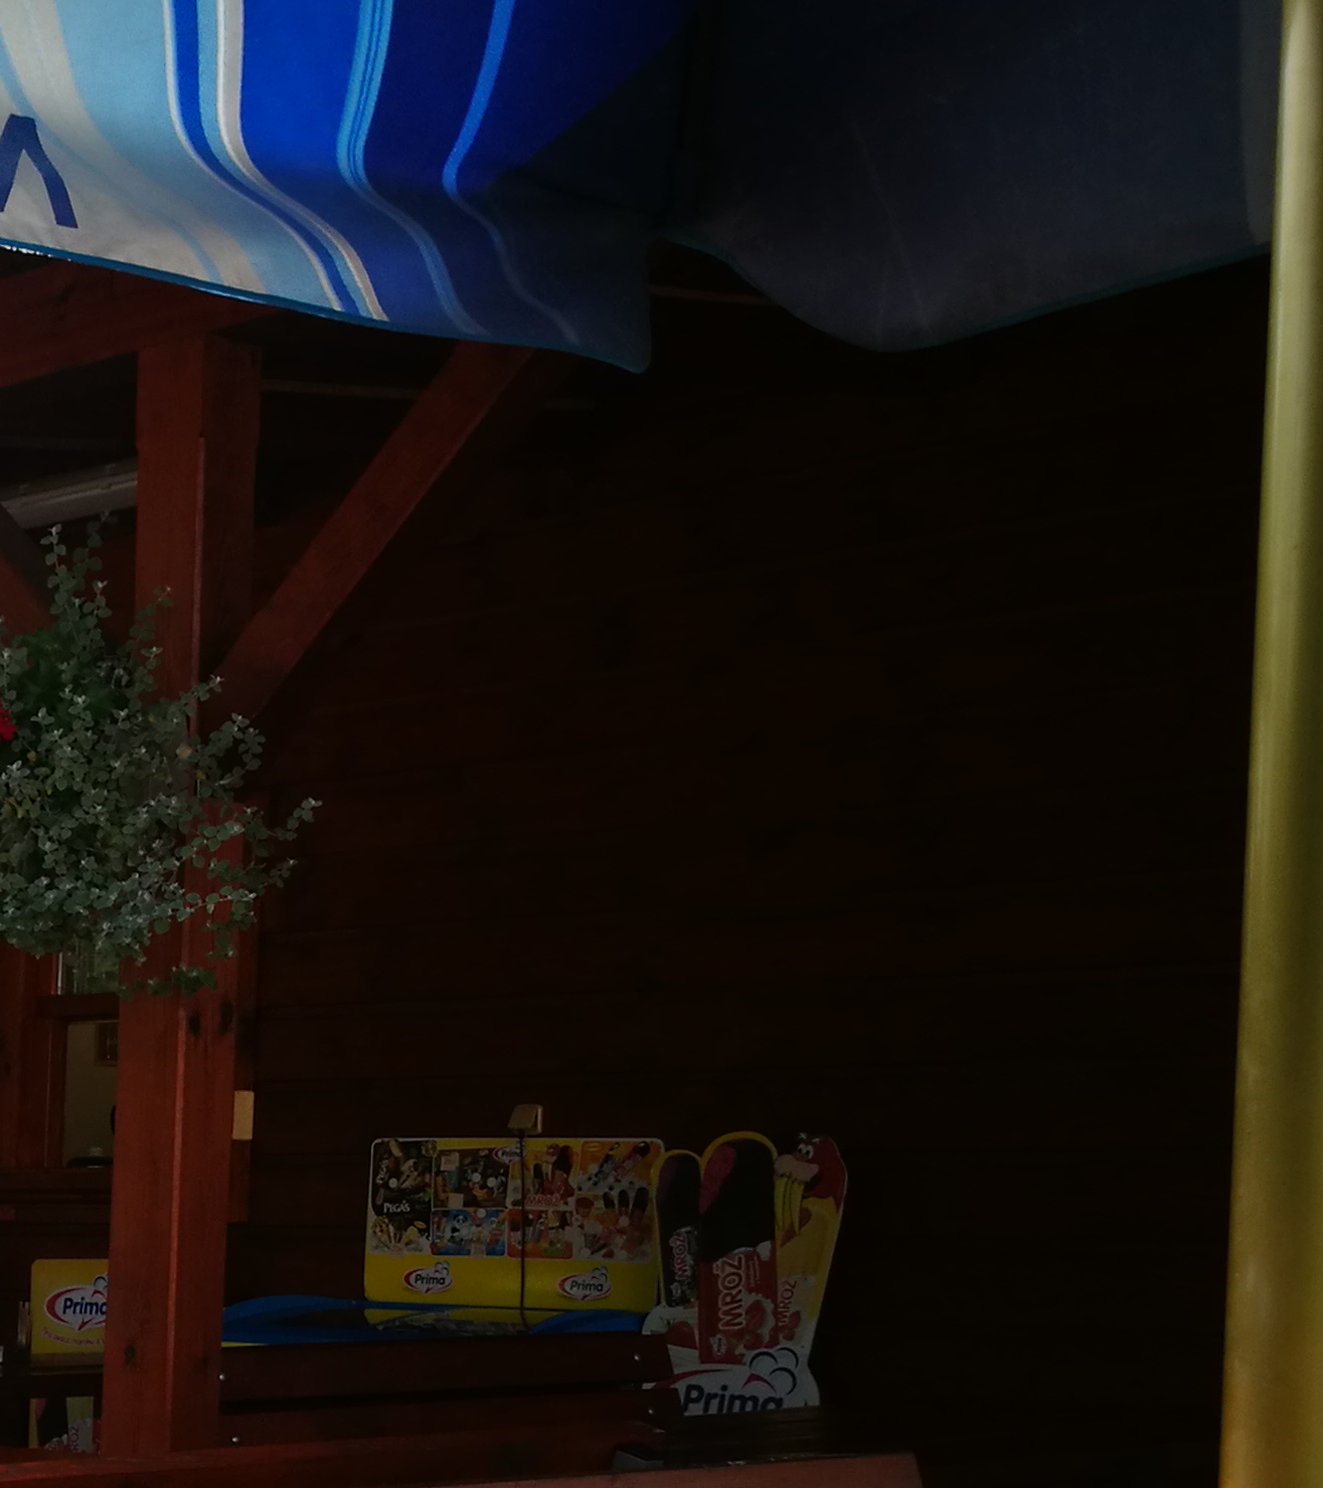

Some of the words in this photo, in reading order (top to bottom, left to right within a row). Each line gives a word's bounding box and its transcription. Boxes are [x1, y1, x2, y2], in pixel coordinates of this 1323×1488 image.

[415, 1270, 447, 1286] Prima
[569, 1278, 604, 1294] Prima
[683, 1384, 784, 1415] Prima
